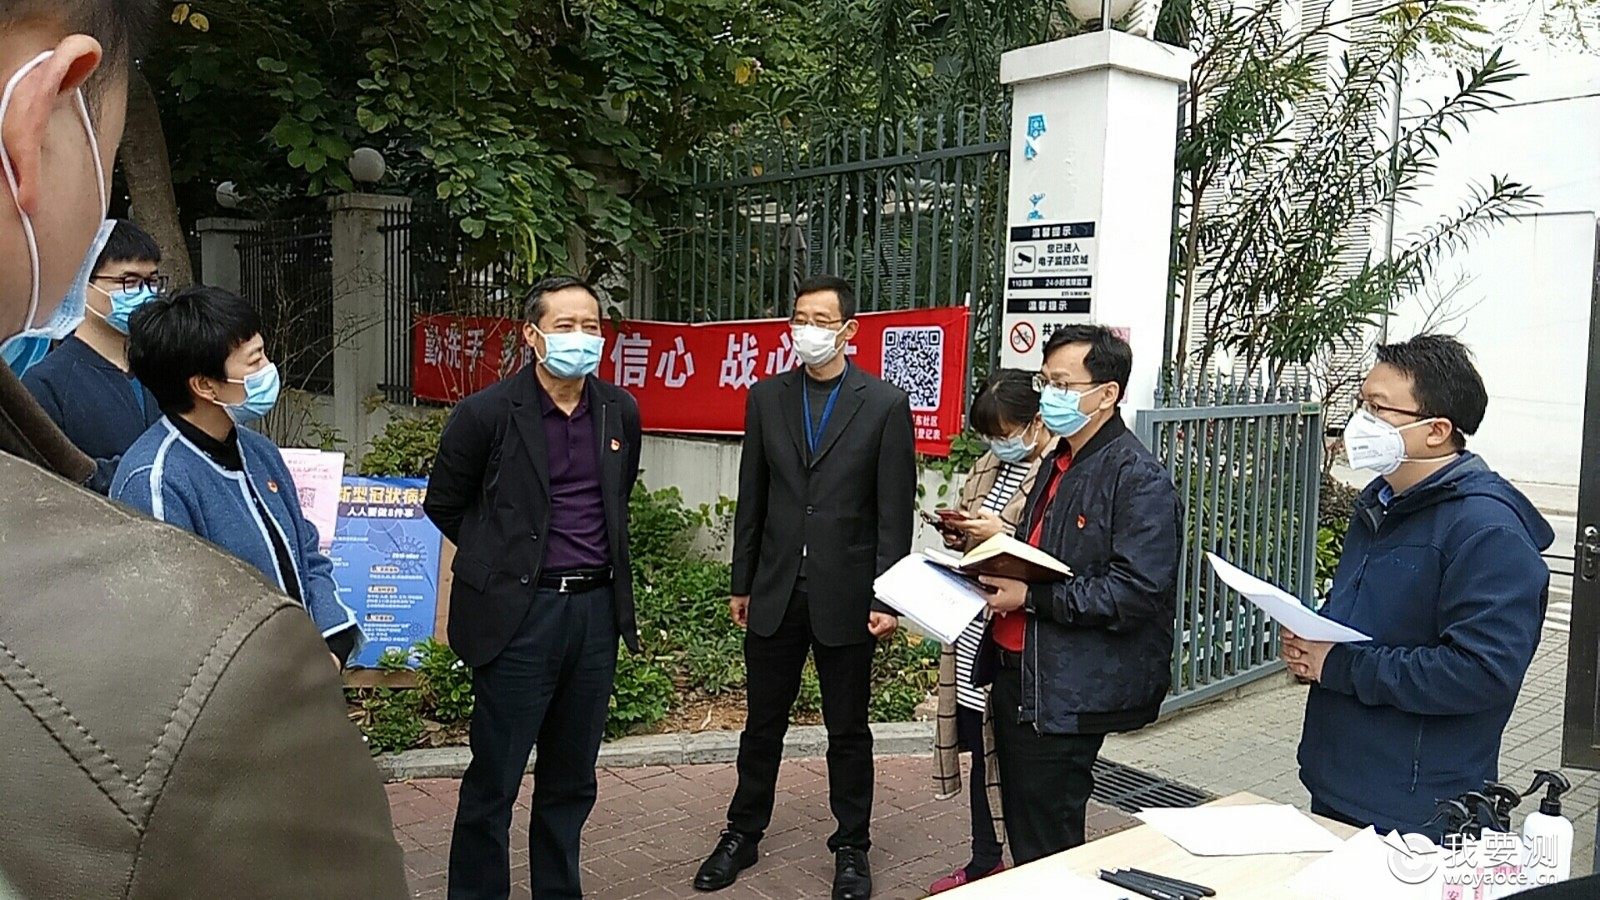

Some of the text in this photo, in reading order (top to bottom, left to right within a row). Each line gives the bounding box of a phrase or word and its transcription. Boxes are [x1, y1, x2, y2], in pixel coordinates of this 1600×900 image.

[1046, 243, 1081, 254] 您已进入
[1038, 255, 1089, 266] 电子监控区域
[1028, 300, 1068, 311] 温馨提示
[593, 332, 695, 389] 信心
[914, 427, 941, 441] 登记表
